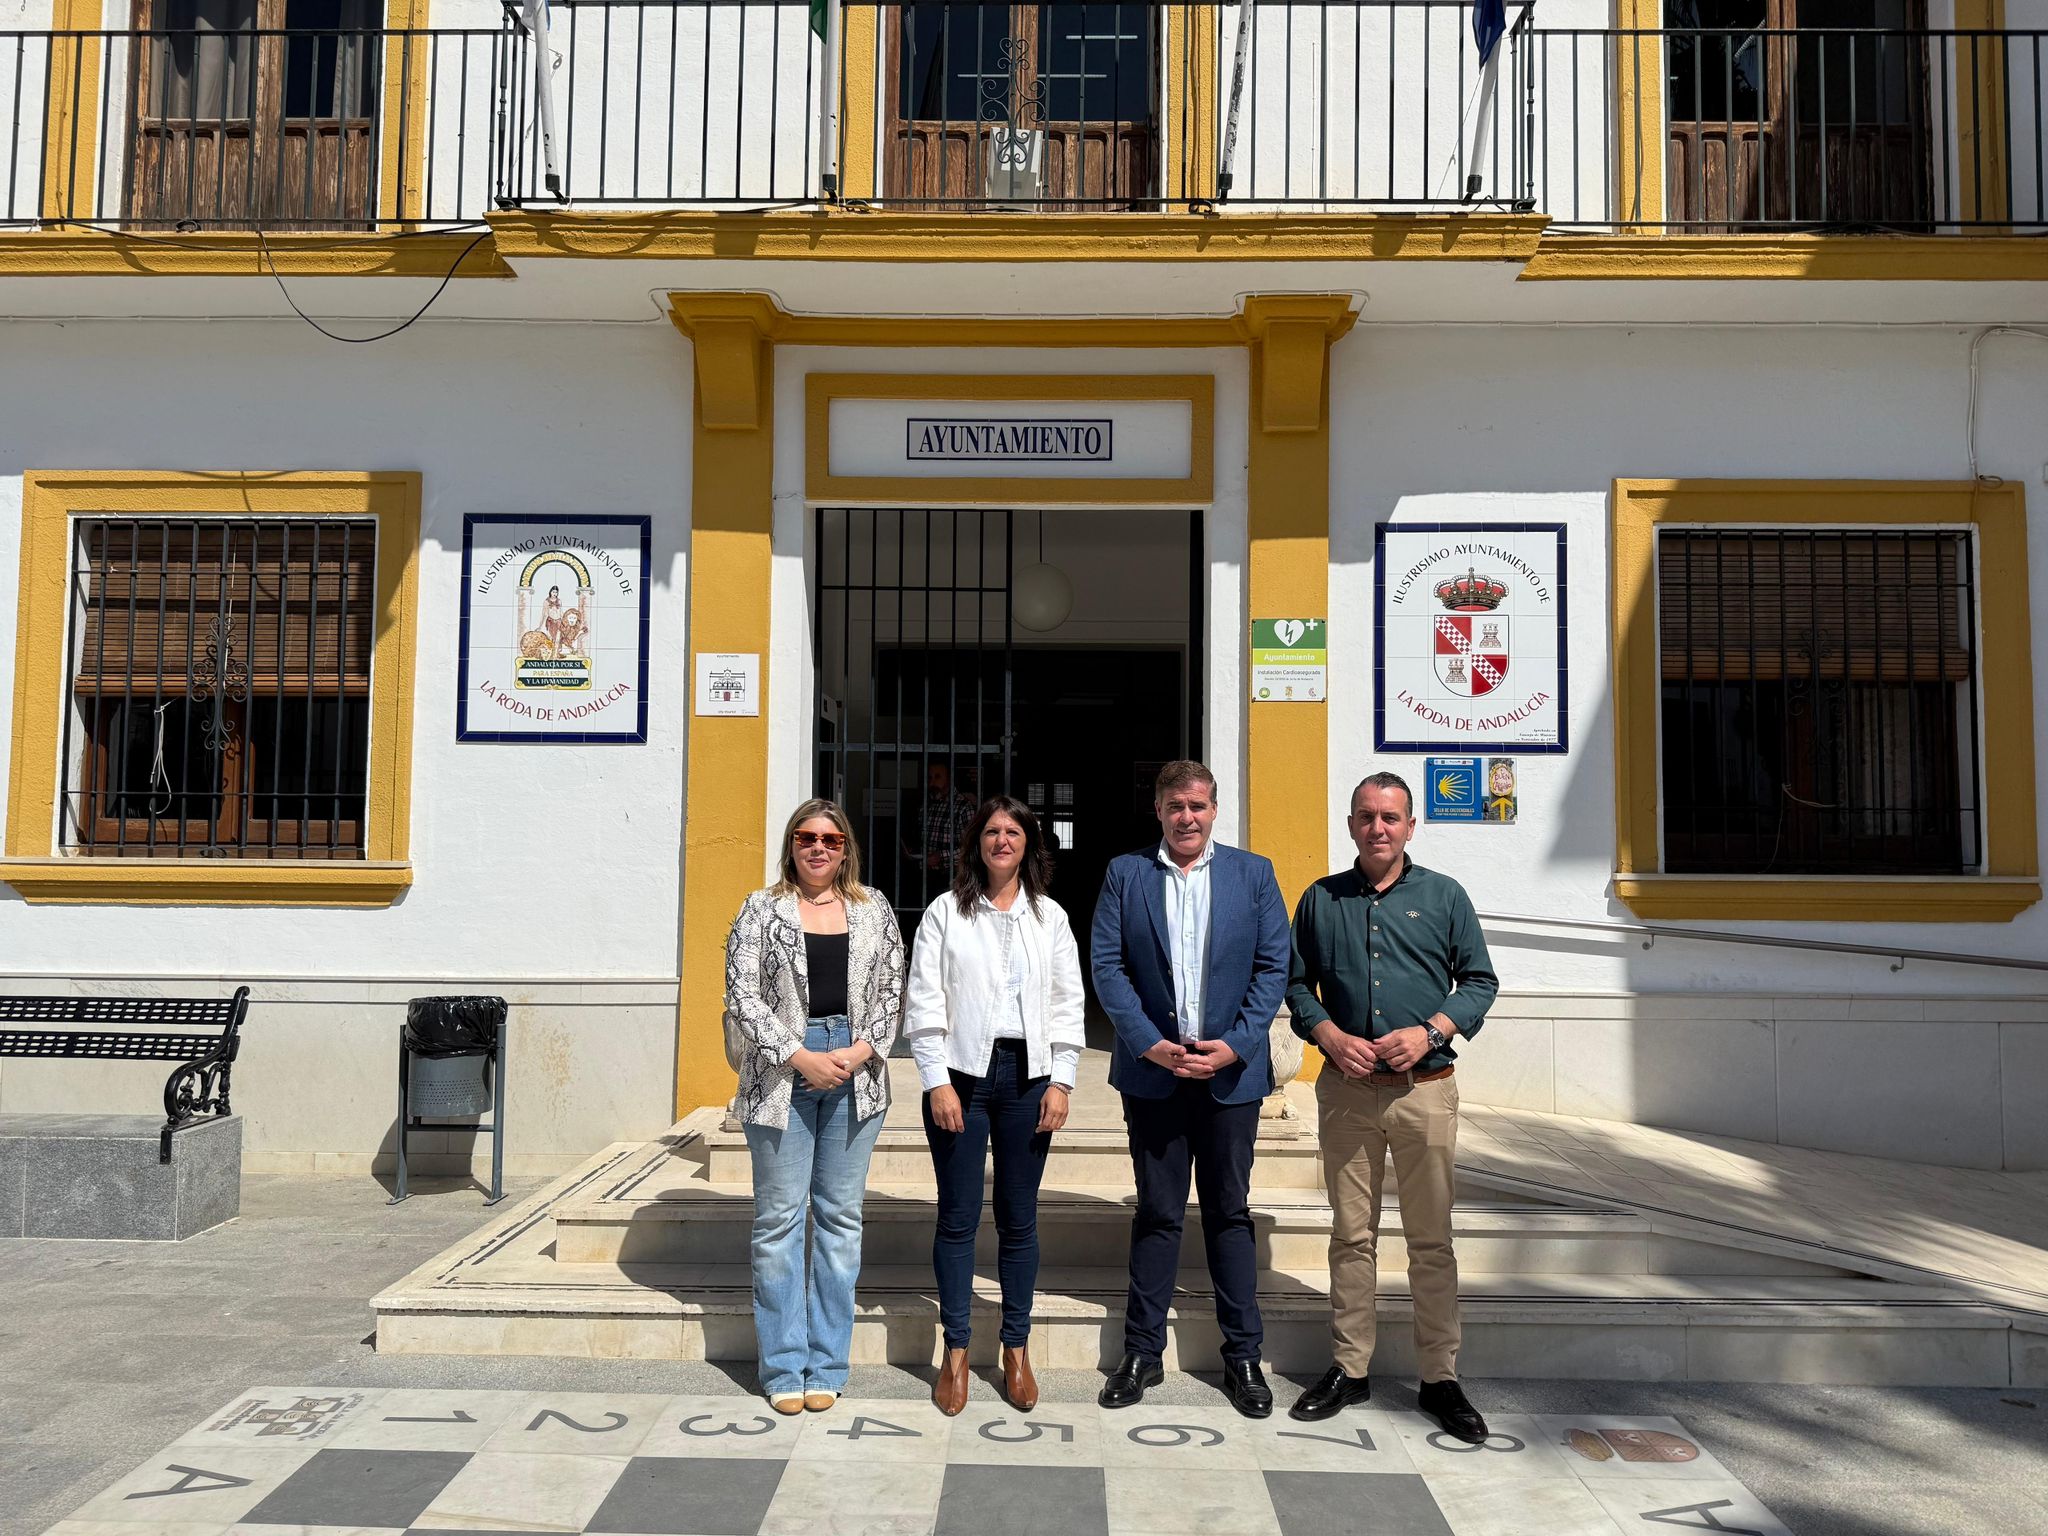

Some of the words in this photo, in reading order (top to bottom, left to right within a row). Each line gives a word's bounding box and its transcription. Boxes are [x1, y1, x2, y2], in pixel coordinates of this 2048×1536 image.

[918, 425, 1102, 455] AYUNTAMIENTO
[478, 539, 535, 594] ILUSTRISIMO
[539, 535, 624, 579] AYUNTAMIENTO
[619, 579, 634, 596] DE
[1392, 548, 1450, 604] ILUSTRISIMO
[1454, 544, 1540, 586] AYUNTAMIENTO
[1536, 588, 1551, 605] DE
[1264, 653, 1315, 662] Ayuntamiento
[550, 669, 573, 677] ESPAÑA
[480, 680, 495, 699] LA
[496, 693, 532, 718] RODA
[536, 709, 553, 721] DE
[558, 682, 631, 721] ANDALUCÍA
[1397, 690, 1412, 708] LA
[1413, 703, 1450, 728] RODA
[1455, 718, 1472, 731] DE
[1477, 691, 1550, 731] ANDALUCÍA
[382, 1409, 479, 1425] 1
[524, 1409, 629, 1433] 2
[679, 1414, 777, 1437] 3
[826, 1416, 924, 1440] 4
[977, 1418, 1074, 1443] 5
[1127, 1423, 1225, 1447] 6
[1277, 1428, 1378, 1452] 7
[1426, 1430, 1525, 1452] 8
[122, 1463, 254, 1501] A
[1638, 1498, 1767, 1536] A
